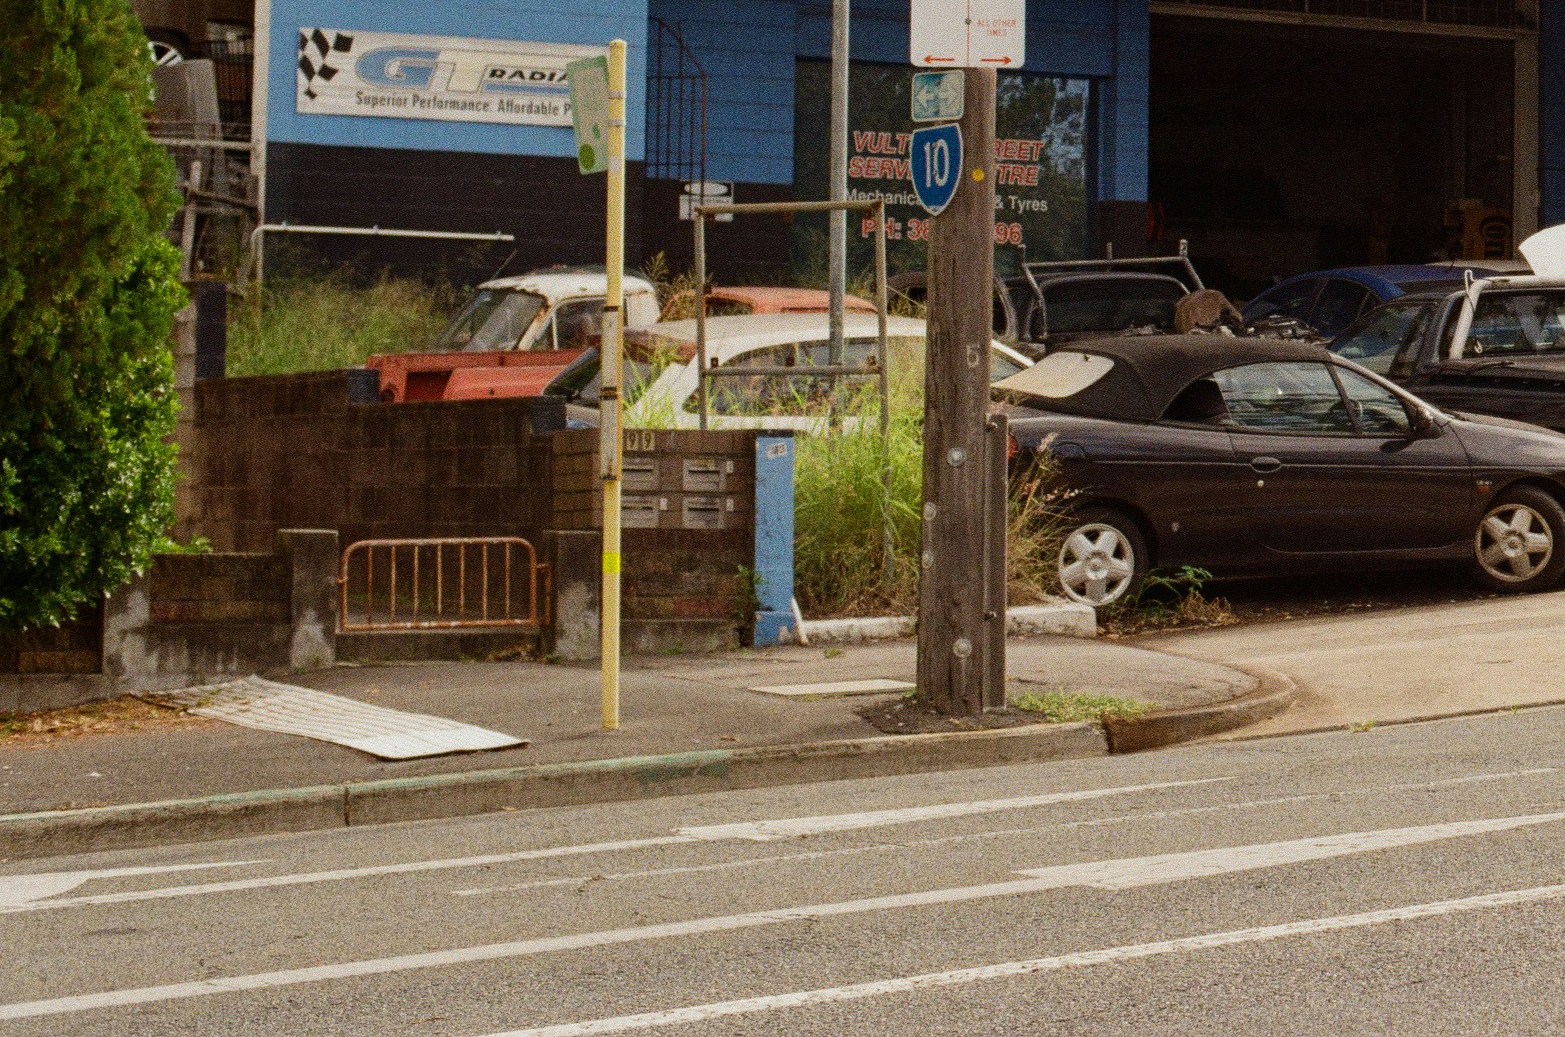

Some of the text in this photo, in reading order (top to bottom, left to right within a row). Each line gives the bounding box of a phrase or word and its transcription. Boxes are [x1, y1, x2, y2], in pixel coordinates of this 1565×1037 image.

[489, 68, 568, 83] RADIA
[355, 90, 408, 109] Superior
[498, 98, 559, 116] Affordable
[853, 129, 1045, 162] VULT REET
[849, 155, 1040, 186] SERV TRE
[924, 138, 950, 188] 10
[846, 188, 921, 206] Mechanic
[1008, 195, 1049, 214] Tyres
